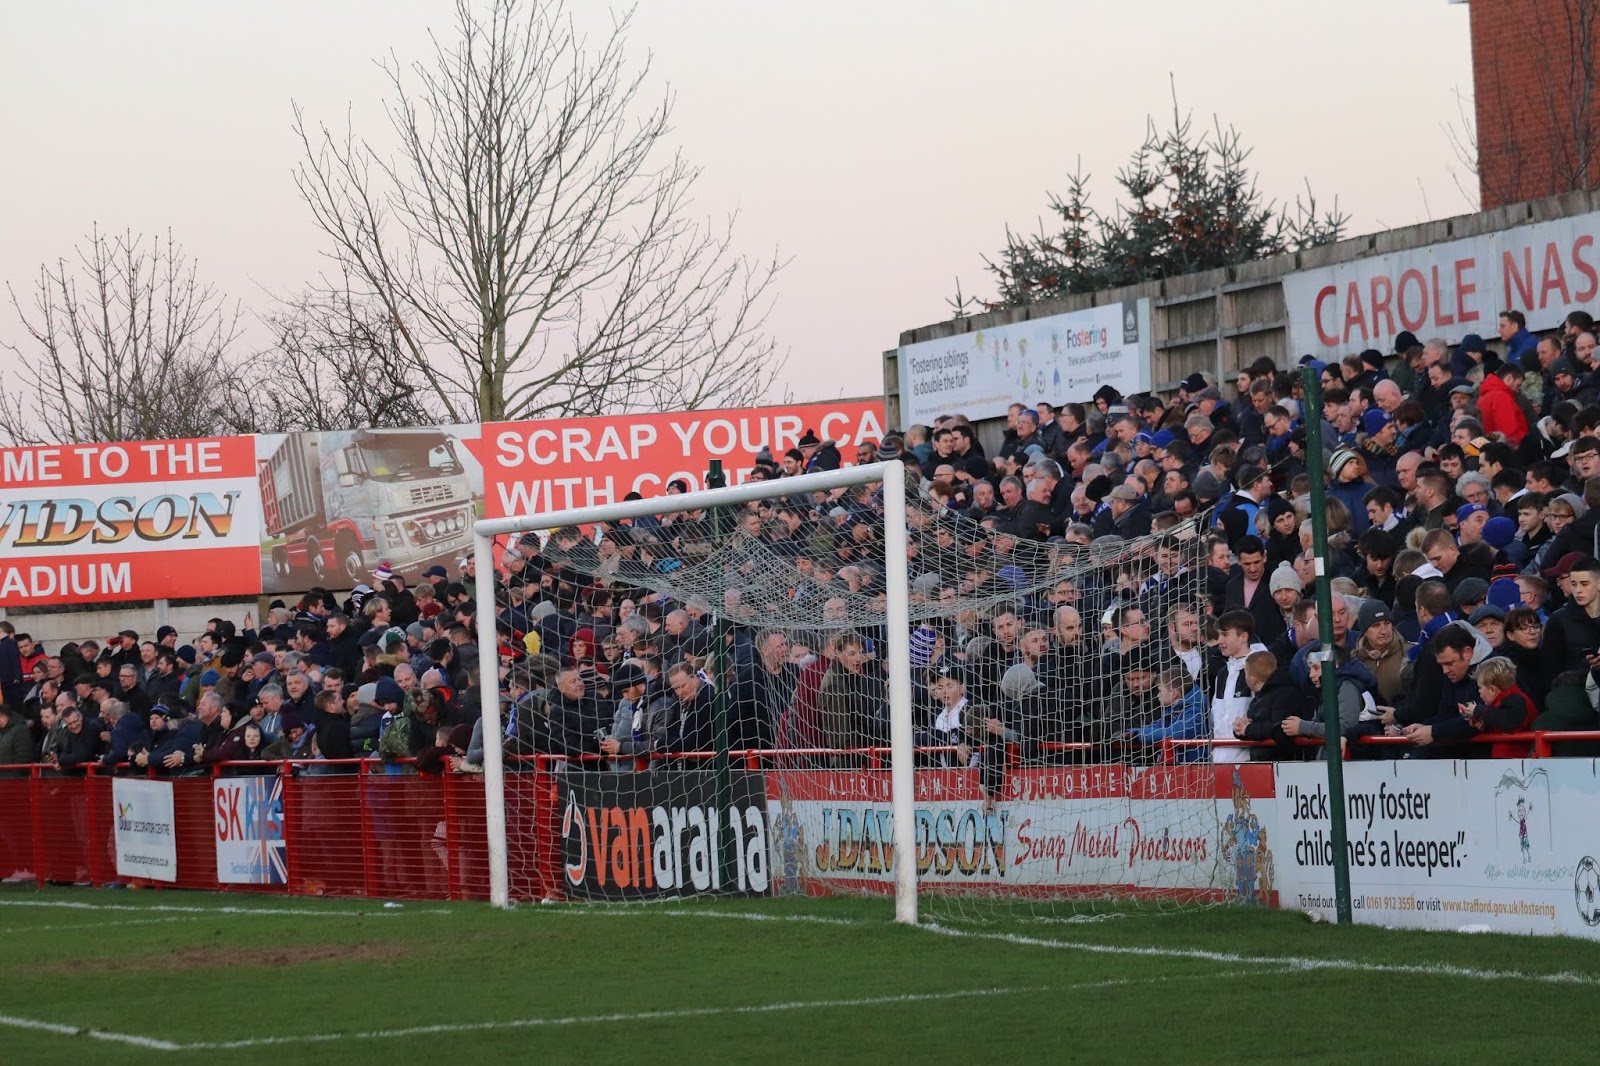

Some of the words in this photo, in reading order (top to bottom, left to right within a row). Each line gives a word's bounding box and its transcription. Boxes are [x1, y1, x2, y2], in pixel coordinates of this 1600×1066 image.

[1314, 258, 1479, 347] CAROLE
[1503, 235, 1598, 312] NAS
[1066, 325, 1107, 349] Fostering
[944, 350, 968, 370] siblings
[913, 380, 919, 396] is
[920, 375, 943, 395] double
[943, 372, 955, 390] the
[497, 424, 658, 467] SCRAP
[670, 415, 802, 457] YOUR
[0, 449, 63, 482] ME
[74, 446, 130, 479] TO
[140, 441, 223, 476] THE
[497, 475, 615, 516] WITH
[0, 562, 132, 599] ADIUM
[829, 777, 941, 797] ALTRINAM
[1012, 772, 1132, 796] SUPPORTED
[1150, 773, 1172, 794] BY
[216, 787, 244, 842] SK
[245, 786, 284, 842] kits
[1348, 793, 1376, 830] my
[1379, 782, 1431, 820] foster
[816, 808, 1009, 877] J.DAVDSON
[1014, 818, 1066, 875] Scrap
[1068, 819, 1119, 867] Metal
[1123, 816, 1207, 869] Processors
[1380, 840, 1391, 867] a
[1298, 894, 1307, 908] To
[1307, 893, 1321, 908] find
[1322, 897, 1333, 908] out
[1353, 895, 1365, 909] call
[1366, 896, 1382, 910] 0161
[1384, 896, 1397, 910] 912
[1399, 896, 1415, 911] 3558
[1416, 899, 1424, 911] or
[1425, 897, 1441, 911] visit
[1442, 899, 1555, 920] www.trafford.gov.uk/fostering
